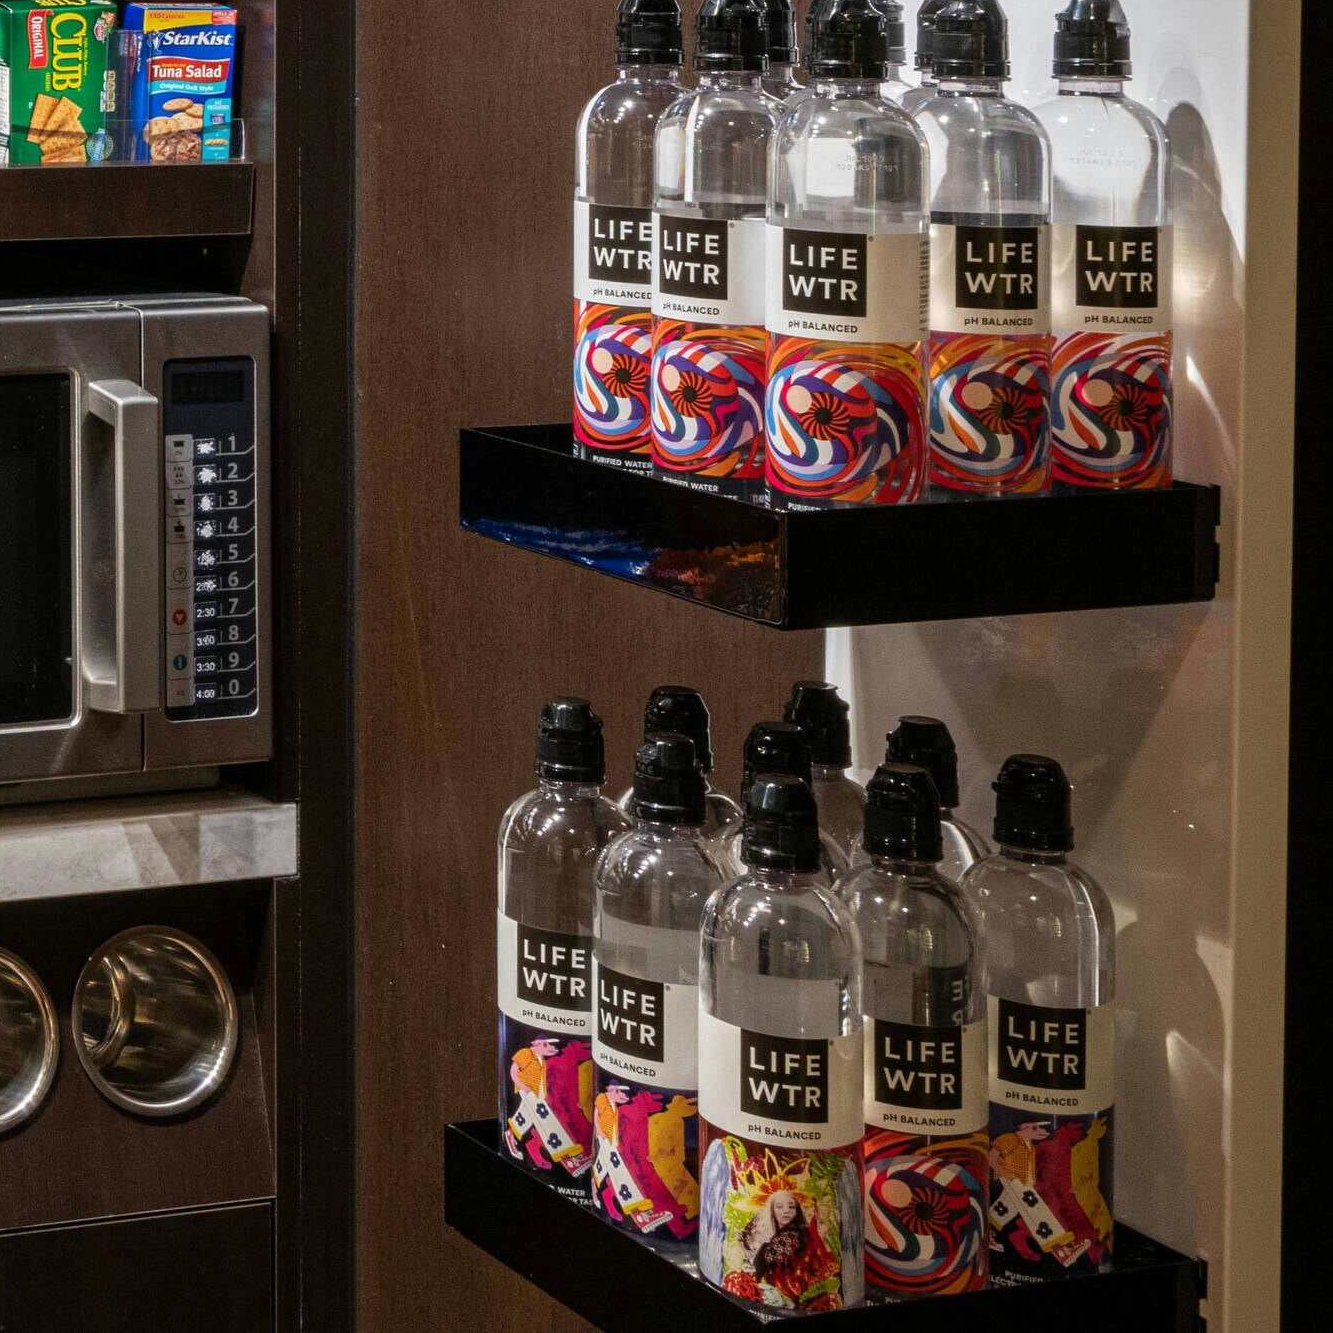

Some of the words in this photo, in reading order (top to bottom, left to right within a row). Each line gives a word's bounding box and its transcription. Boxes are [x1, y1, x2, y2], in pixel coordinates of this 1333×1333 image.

[33, 16, 44, 59] ORIGINAL
[162, 30, 233, 46] StarKist
[51, 12, 88, 92] CLUB
[152, 64, 184, 78] Tuna
[186, 64, 222, 78] Salad
[594, 217, 652, 242] LIFE
[663, 229, 719, 255] LIFE
[593, 246, 652, 271] WTR
[789, 243, 858, 270] LIFE
[966, 241, 1033, 264] LIFE
[1087, 240, 1153, 262] LIFE
[663, 258, 719, 285] WTR
[965, 272, 1033, 294] WTR
[1085, 270, 1153, 293] WTR
[789, 274, 858, 302] WTR
[802, 321, 859, 334] BALANCED
[1102, 315, 1153, 325] BALANCED
[197, 607, 215, 618] 2:30
[197, 662, 215, 672] 3:30
[523, 938, 587, 969] LIFE
[522, 966, 587, 997] WTR
[600, 978, 656, 1017] LIFE
[600, 1008, 656, 1046] WTR
[1008, 1016, 1079, 1045] LIFE
[749, 1046, 821, 1077] LIFE
[885, 1037, 955, 1064] LIFE
[1007, 1045, 1079, 1075] WTR
[749, 1077, 821, 1107] WTR
[884, 1067, 955, 1094] WTR
[900, 1114, 956, 1127] BALANCED
[764, 1127, 822, 1141] BALANCED
